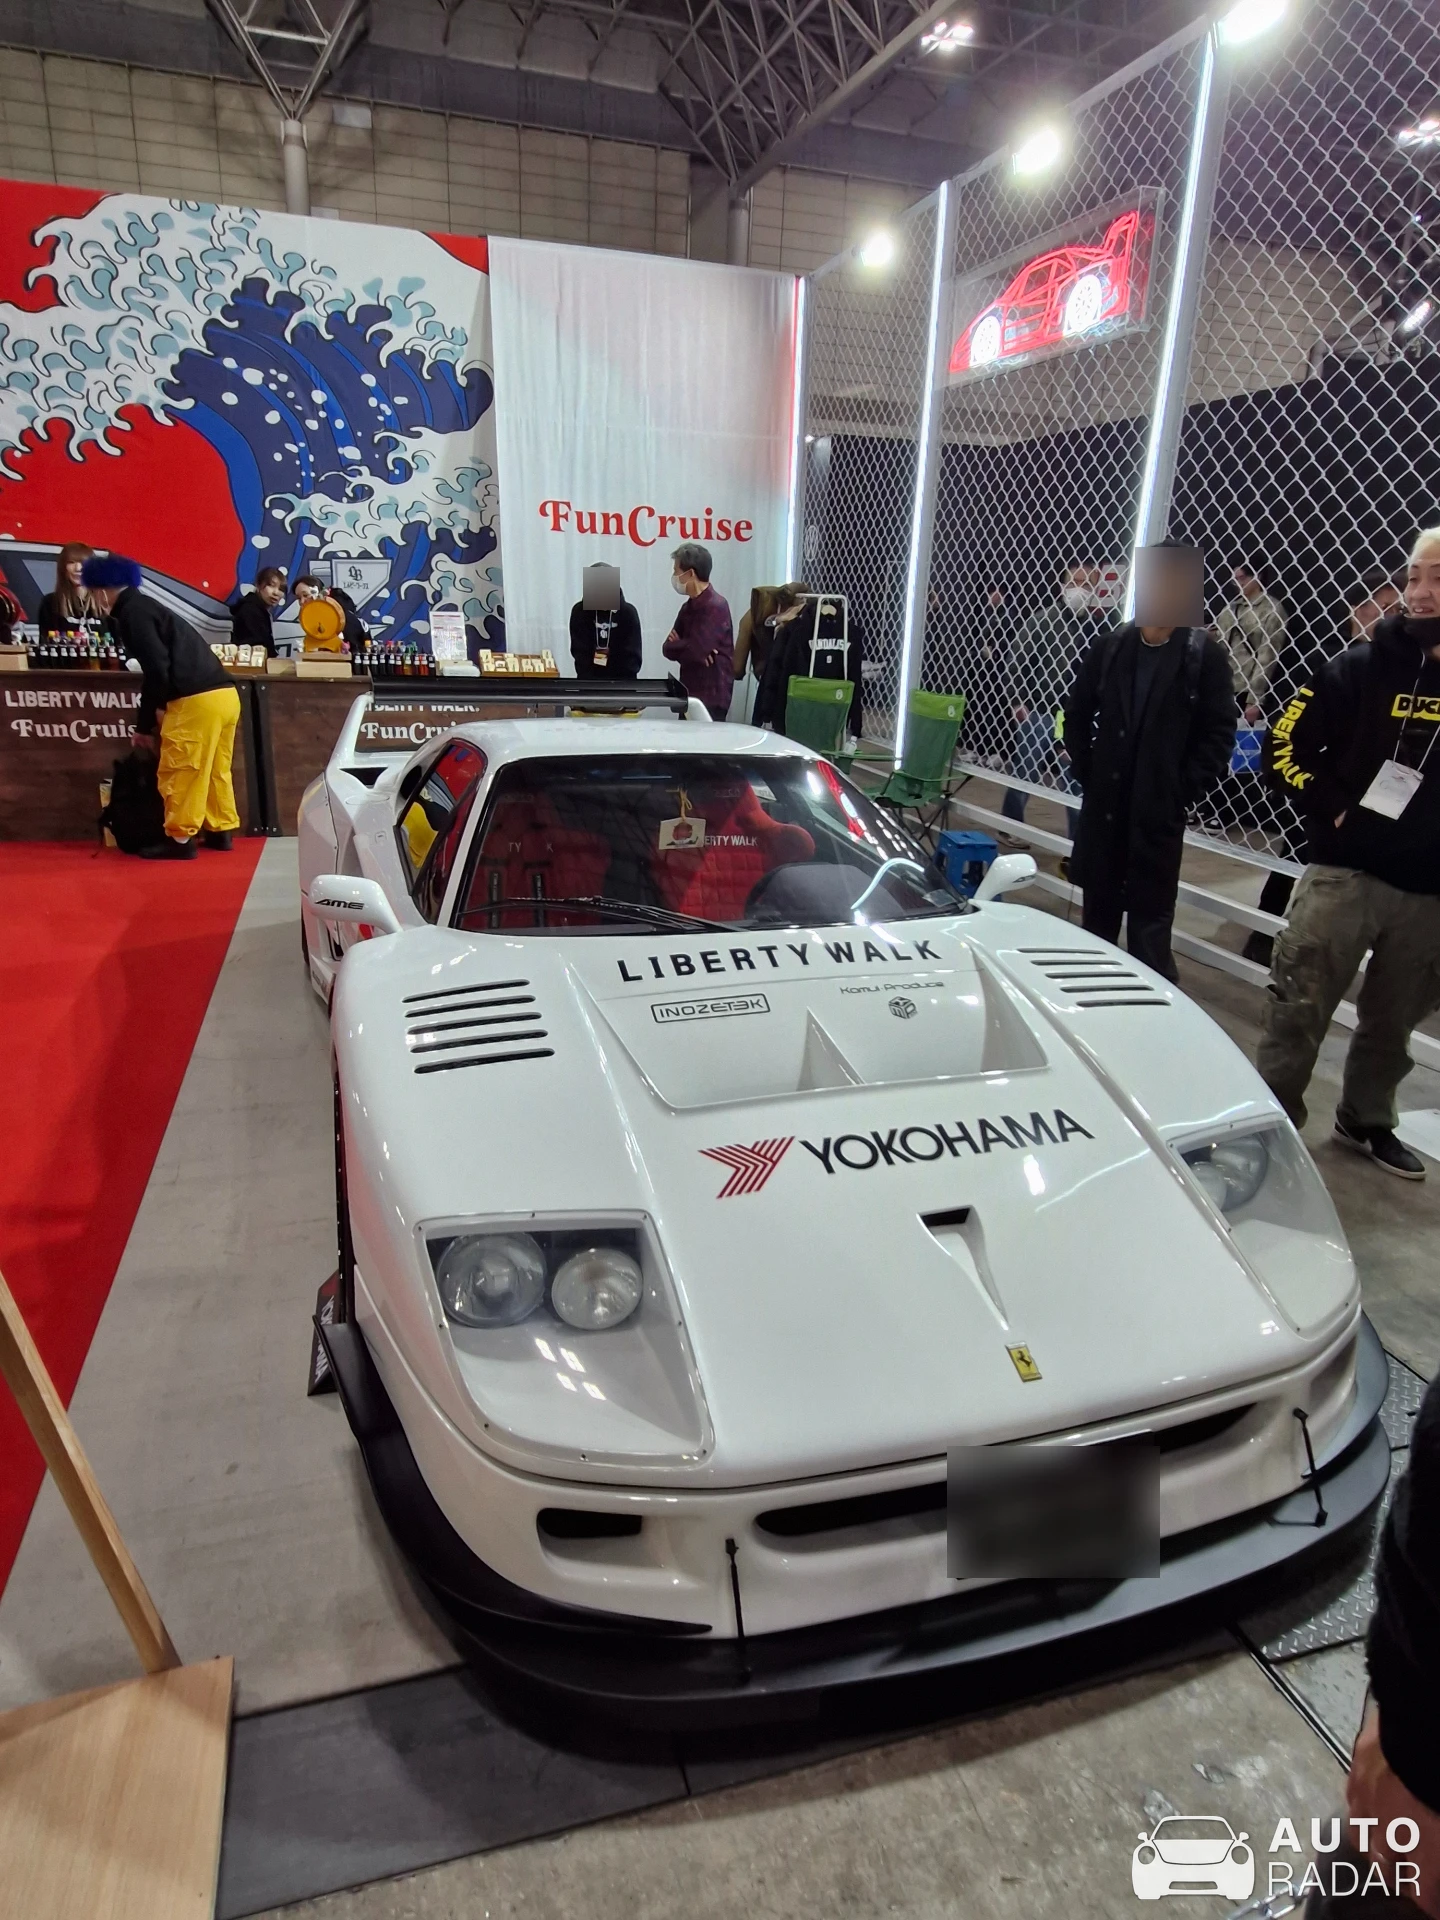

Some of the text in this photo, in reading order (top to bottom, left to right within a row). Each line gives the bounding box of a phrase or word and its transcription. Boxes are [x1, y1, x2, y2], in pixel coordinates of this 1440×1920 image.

[539, 500, 753, 547] FunCruise
[4, 690, 142, 708] LIBERTY WALK
[1396, 696, 1440, 716] DUC
[731, 835, 758, 847] WALK
[314, 898, 365, 911] AME
[617, 939, 943, 983] LIBERTY WALK
[798, 1108, 1096, 1175] YOKOHAMA
